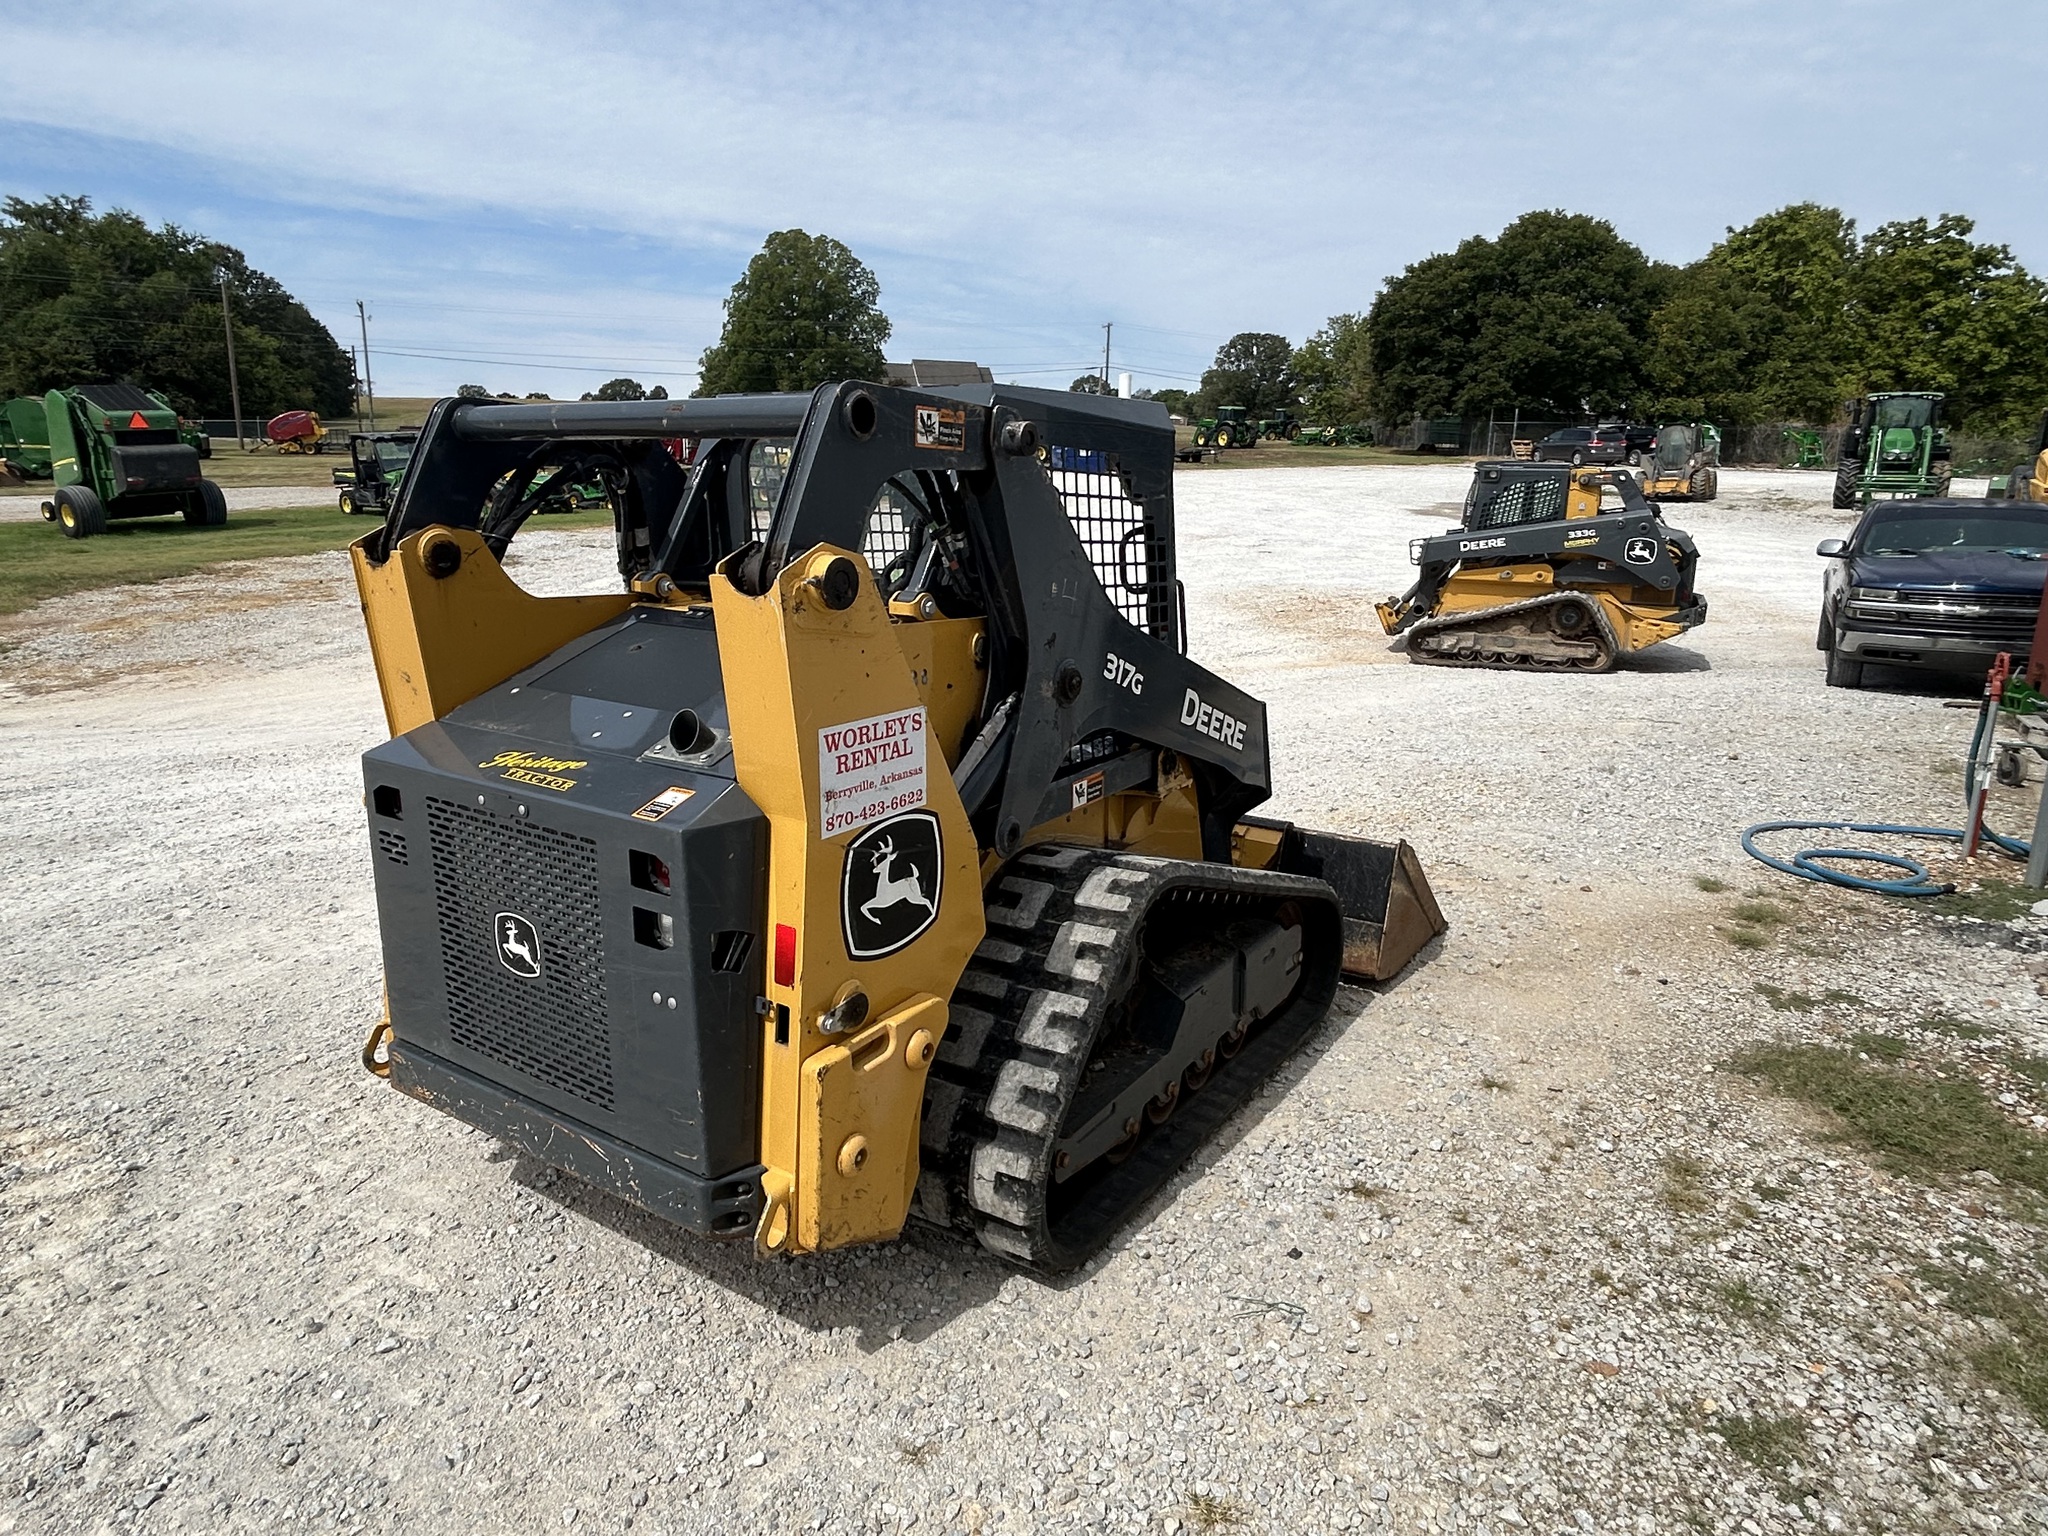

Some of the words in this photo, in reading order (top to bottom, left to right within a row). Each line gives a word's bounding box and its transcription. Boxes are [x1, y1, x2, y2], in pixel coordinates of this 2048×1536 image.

[1460, 537, 1507, 552] DEERE
[1567, 529, 1596, 539] 333G
[1103, 652, 1145, 695] 317G
[823, 712, 923, 754] WORLEY'S
[1180, 687, 1248, 751] DEERE
[478, 751, 589, 772] Heritage
[835, 738, 914, 775] RENTAL
[502, 768, 576, 791] TRACTOR
[824, 779, 878, 803] Berryville,
[879, 766, 924, 787] Arkansas
[825, 788, 924, 832] 870-423-6622
